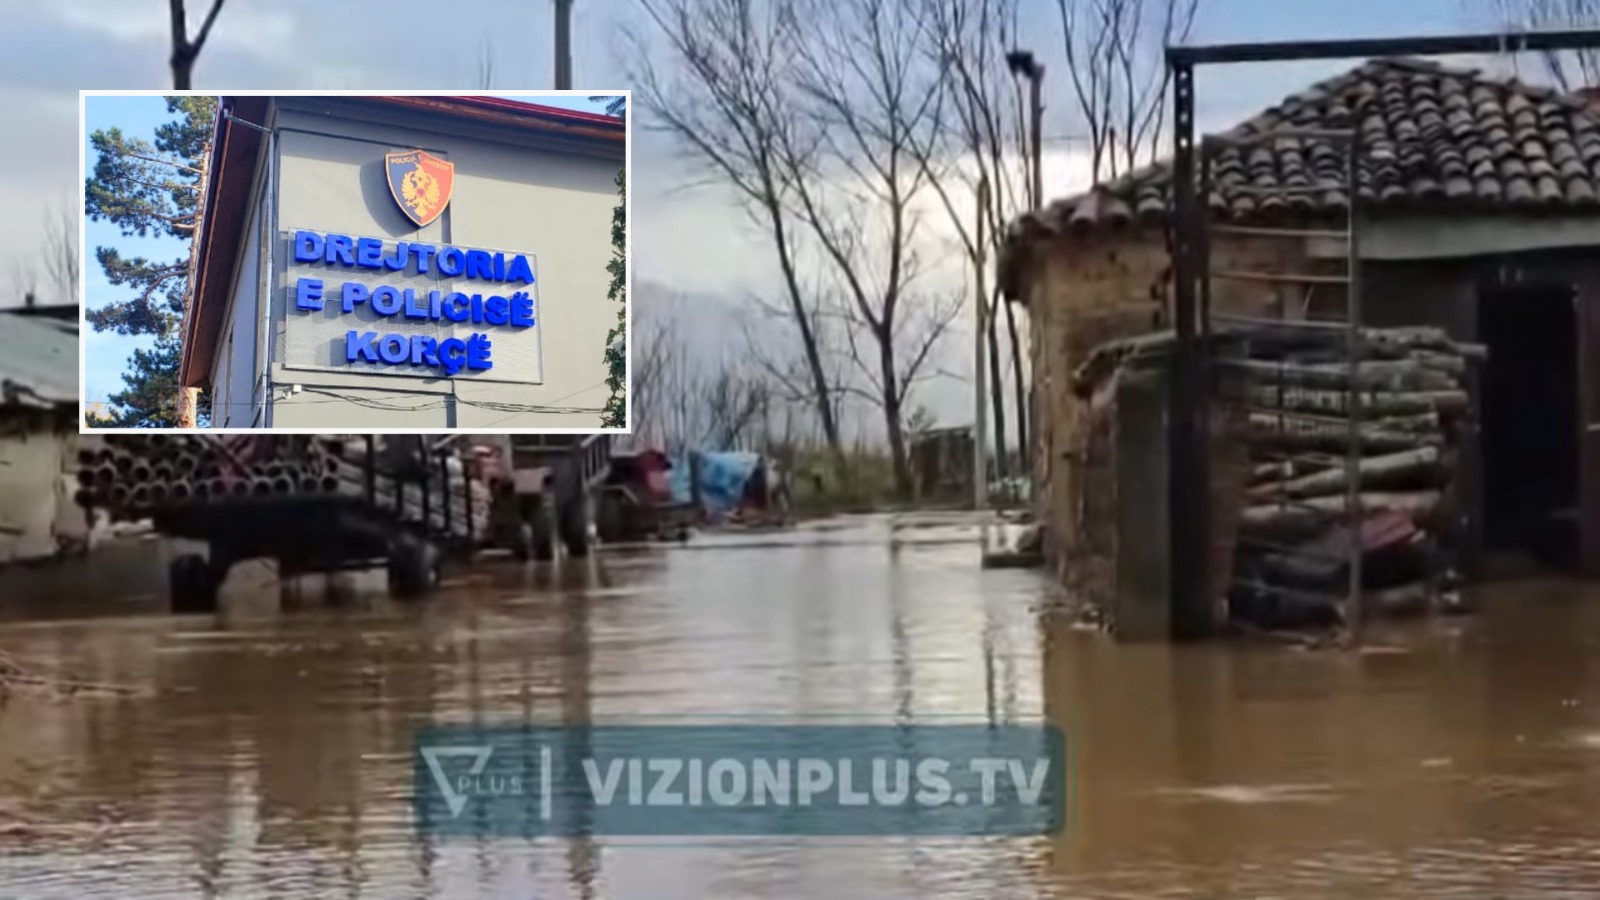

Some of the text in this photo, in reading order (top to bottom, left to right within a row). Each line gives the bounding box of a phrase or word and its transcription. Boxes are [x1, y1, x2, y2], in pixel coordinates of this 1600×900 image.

[295, 231, 535, 283] DREJTORIA
[297, 279, 535, 327] E POLICISË
[346, 331, 492, 375] KORÇË
